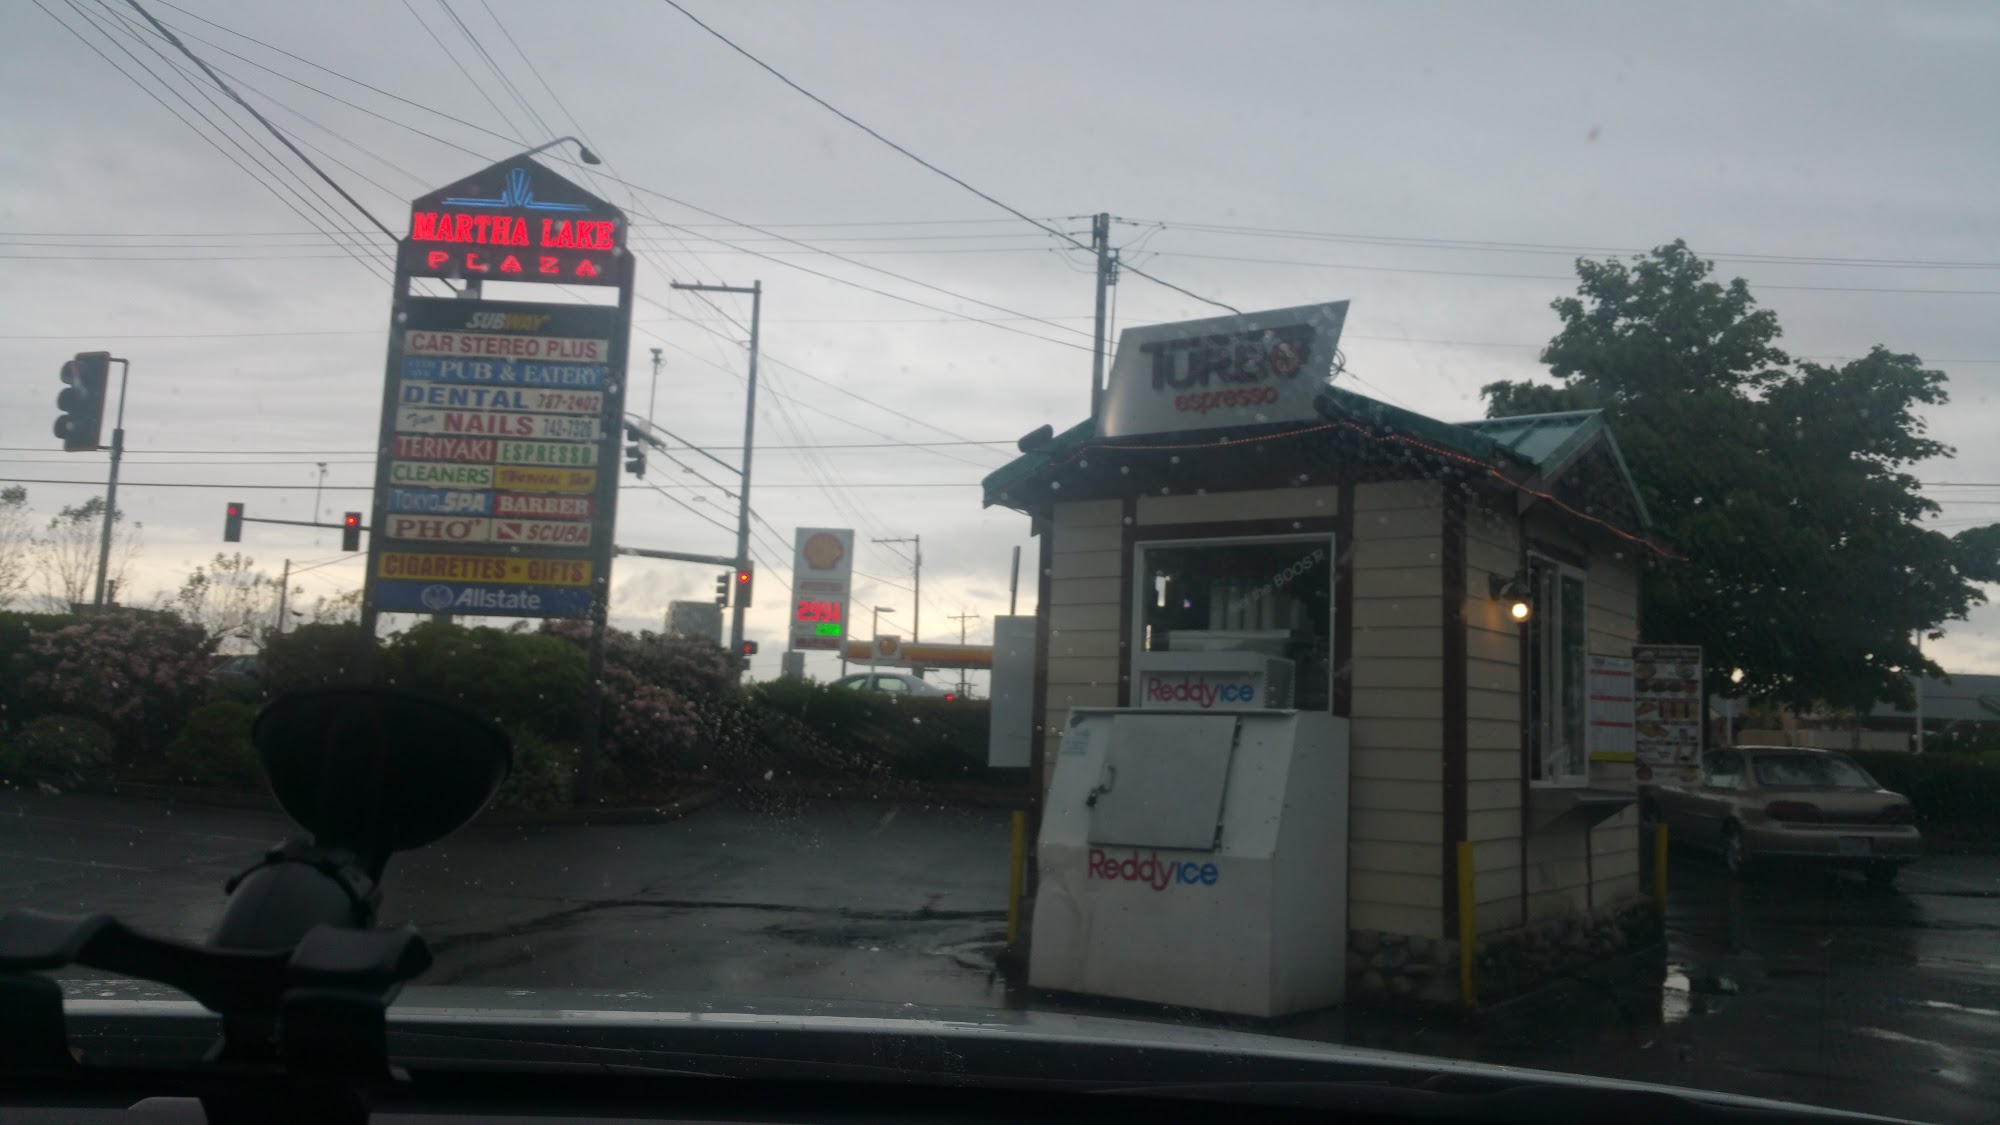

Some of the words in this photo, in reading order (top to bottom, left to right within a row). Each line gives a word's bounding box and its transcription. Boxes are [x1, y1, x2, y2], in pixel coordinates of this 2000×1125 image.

[412, 212, 530, 246] MARTHA
[540, 218, 616, 250] LAKE
[427, 250, 598, 277] PLAZA
[466, 312, 552, 331] SUBWAY
[411, 333, 453, 352] CAR
[460, 336, 540, 357] STEREO
[545, 340, 599, 359] PLUS
[1140, 324, 1315, 391] TURBO
[440, 360, 492, 379] PUB
[500, 364, 516, 382] &
[524, 366, 599, 385] EATERY
[404, 385, 530, 410] DENTAL
[1174, 385, 1278, 414] espresso
[443, 413, 534, 436] NAILS
[398, 436, 494, 461] TERIYAKI
[502, 443, 592, 465] ESPRESSO
[392, 464, 490, 485] CLEANERS
[444, 491, 486, 513] SPA
[499, 495, 590, 515] BARBER
[526, 523, 590, 543] SCUBA
[384, 554, 506, 579] CIGARETTES
[527, 560, 585, 583] GIFTS
[455, 587, 542, 609] Allstate
